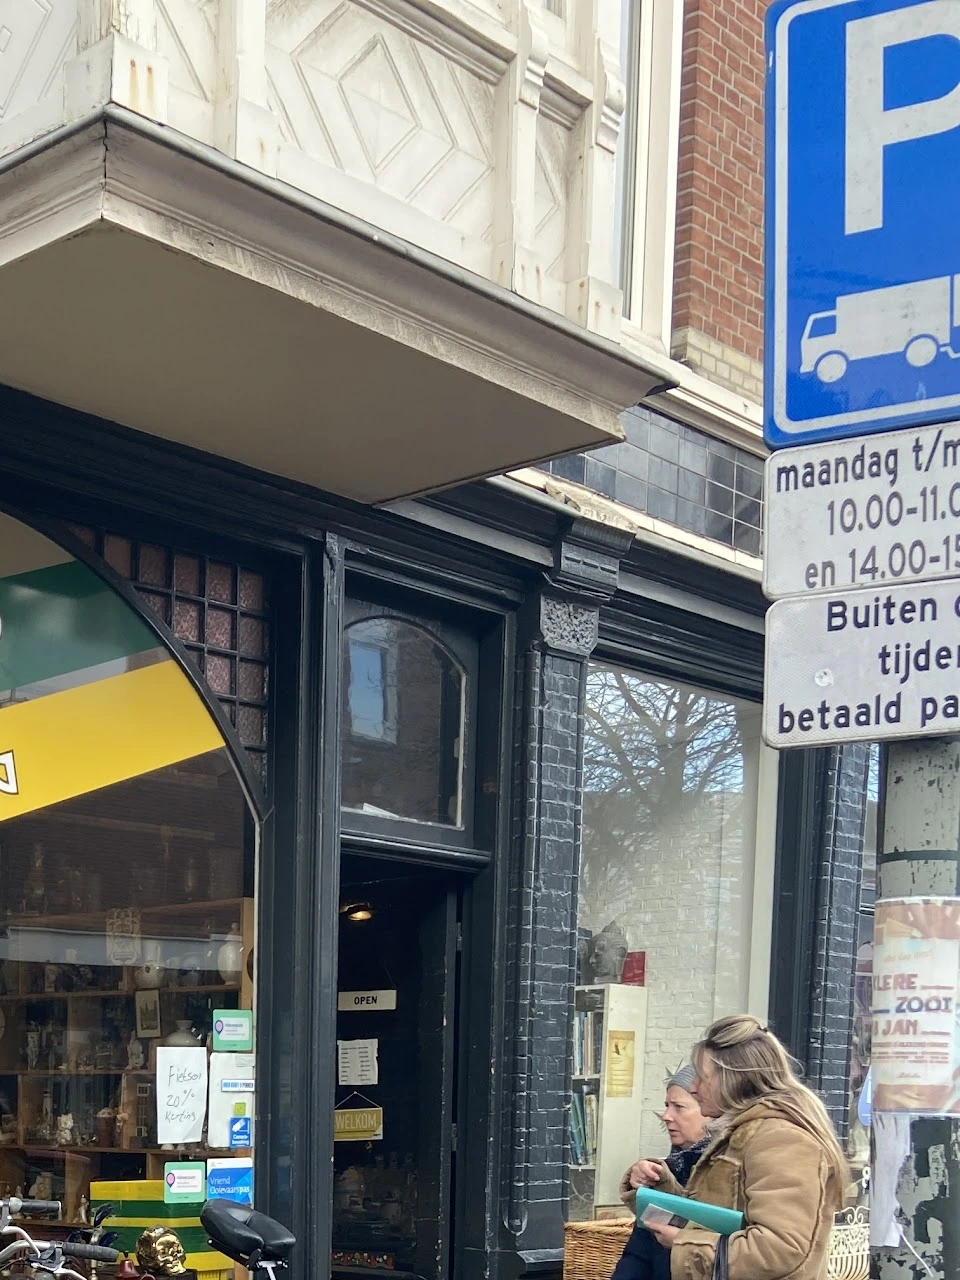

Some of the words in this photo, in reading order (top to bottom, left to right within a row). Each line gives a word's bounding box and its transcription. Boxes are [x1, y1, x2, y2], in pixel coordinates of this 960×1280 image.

[845, 1, 960, 235] P
[776, 444, 899, 493] maandag
[912, 429, 960, 472] t/m
[805, 559, 836, 589] en
[827, 595, 938, 632] Buiten
[878, 638, 960, 684] tijde
[778, 691, 902, 734] betaald
[920, 694, 959, 729] pa
[353, 995, 378, 1006] OPEN
[882, 1019, 918, 1036] JAN
[335, 1113, 377, 1130] WELKOM
[210, 1176, 231, 1185] Vriend
